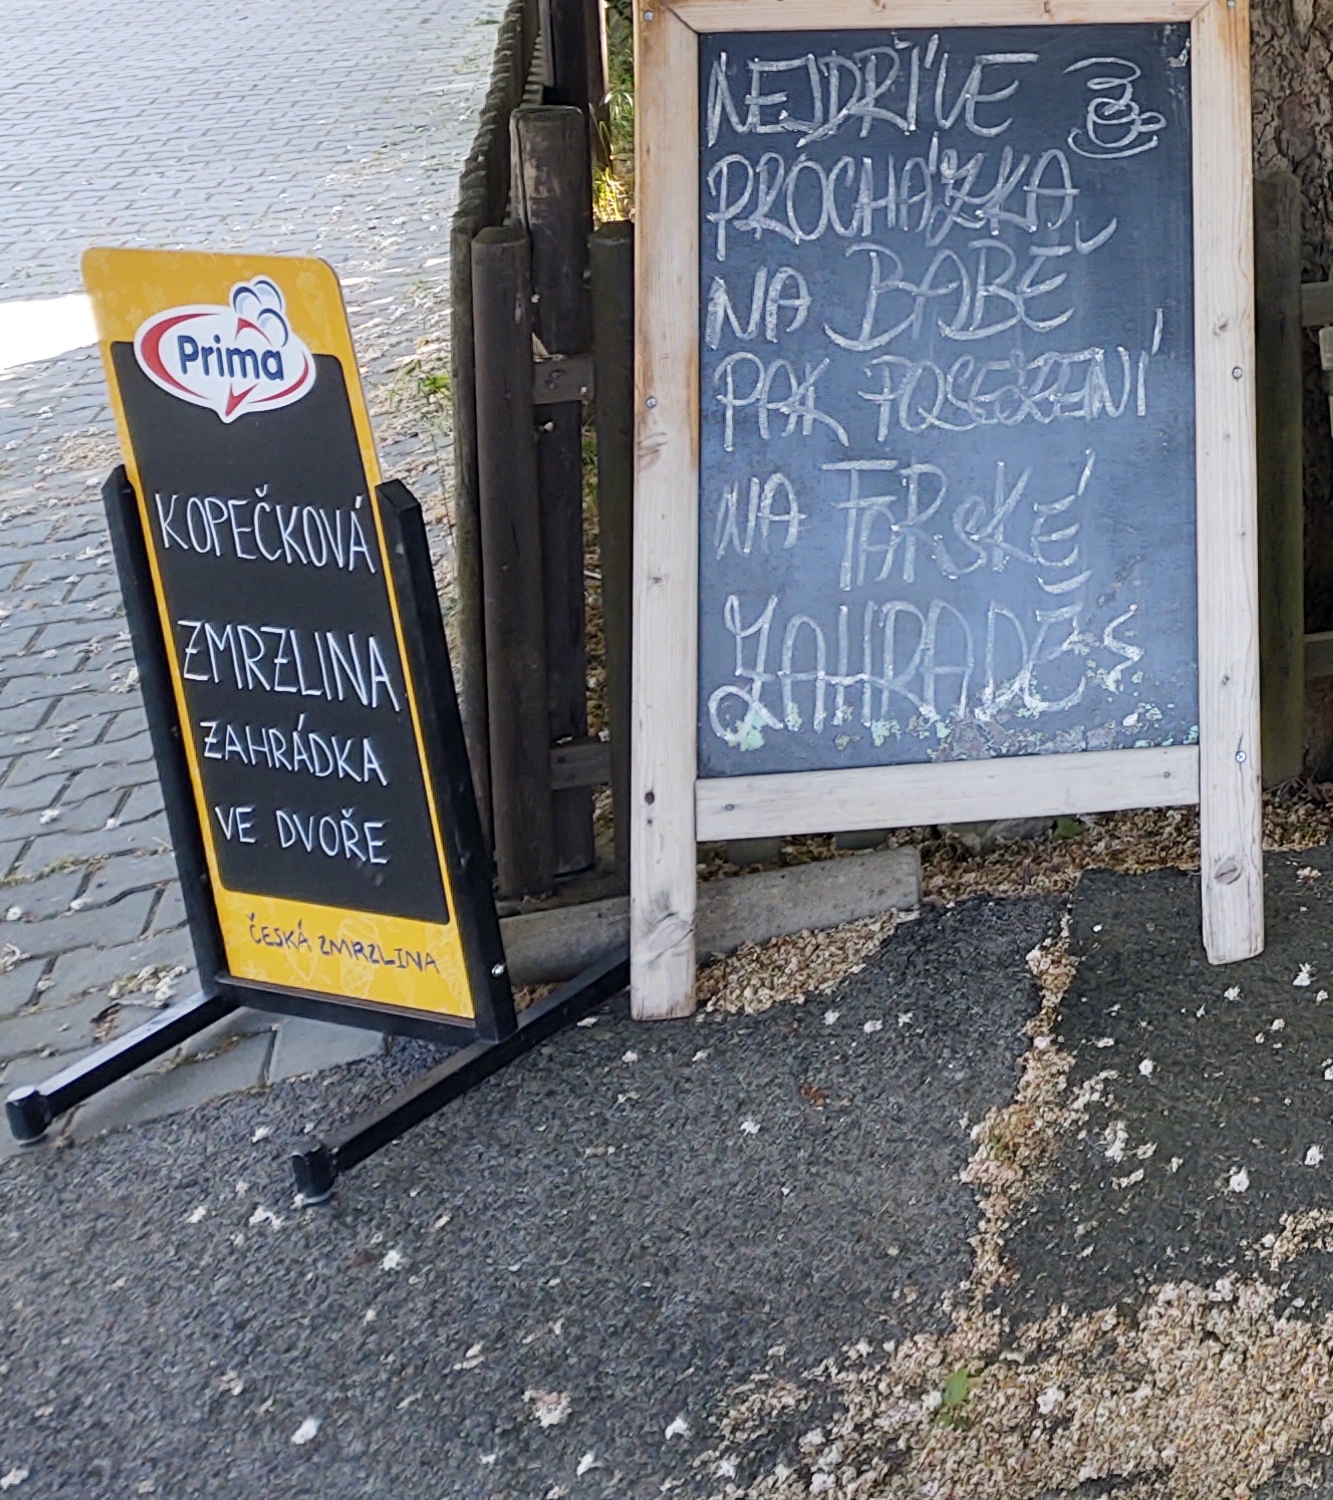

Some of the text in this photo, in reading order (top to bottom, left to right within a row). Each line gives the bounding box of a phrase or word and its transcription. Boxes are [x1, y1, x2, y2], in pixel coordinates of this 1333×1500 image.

[705, 134, 1081, 262] PROCHÁZKA
[707, 217, 1118, 352] NA BABĚ
[176, 333, 285, 382] Prima
[714, 352, 849, 452] PAK
[154, 481, 378, 575] KOPEČKOVÁ
[715, 449, 1095, 591] NA FARSKÉ
[177, 618, 401, 713] ZMRZLINA
[200, 713, 389, 787] ZAHRÁDKA
[214, 804, 390, 866] VE DVOŘE
[246, 911, 441, 975] ČESKÁ ZMRZLINA
